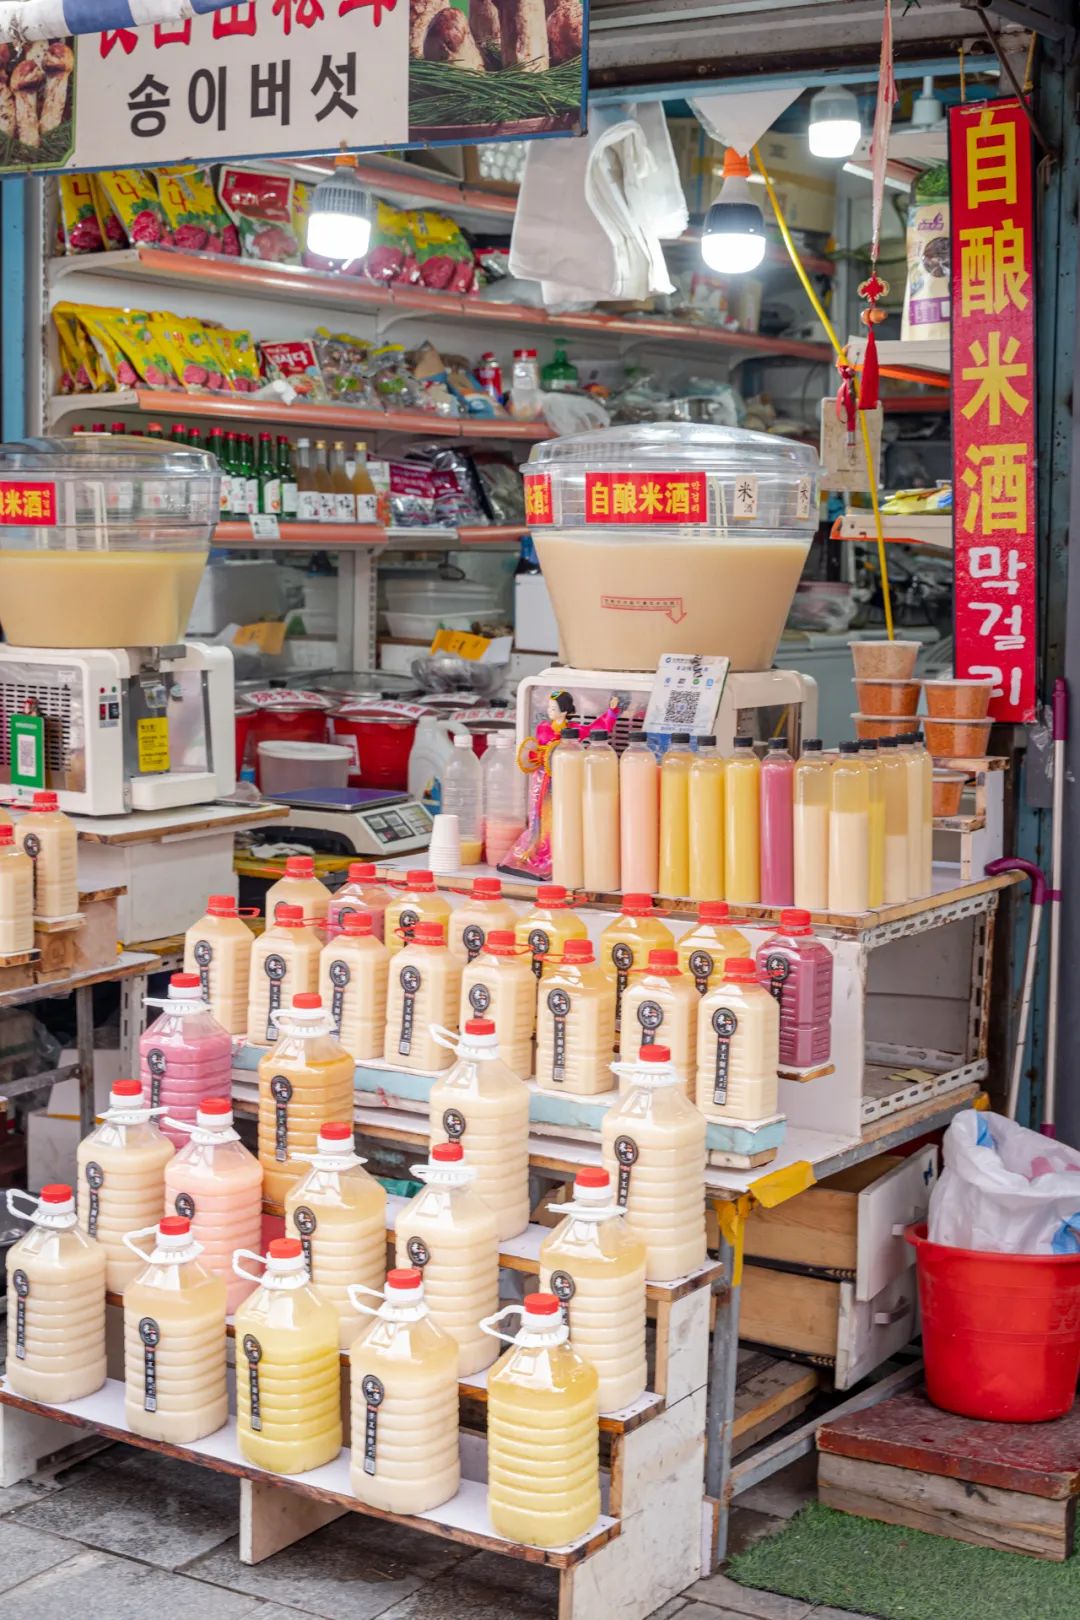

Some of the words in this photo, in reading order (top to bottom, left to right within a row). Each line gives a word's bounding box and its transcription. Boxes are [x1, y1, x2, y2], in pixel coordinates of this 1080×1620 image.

[127, 52, 358, 138] 송이버섯
[960, 109, 1030, 535] 自酿米酒
[0, 488, 43, 518] 米酒
[591, 481, 690, 515] 自酿米酒
[964, 546, 1027, 706] 막걸리
